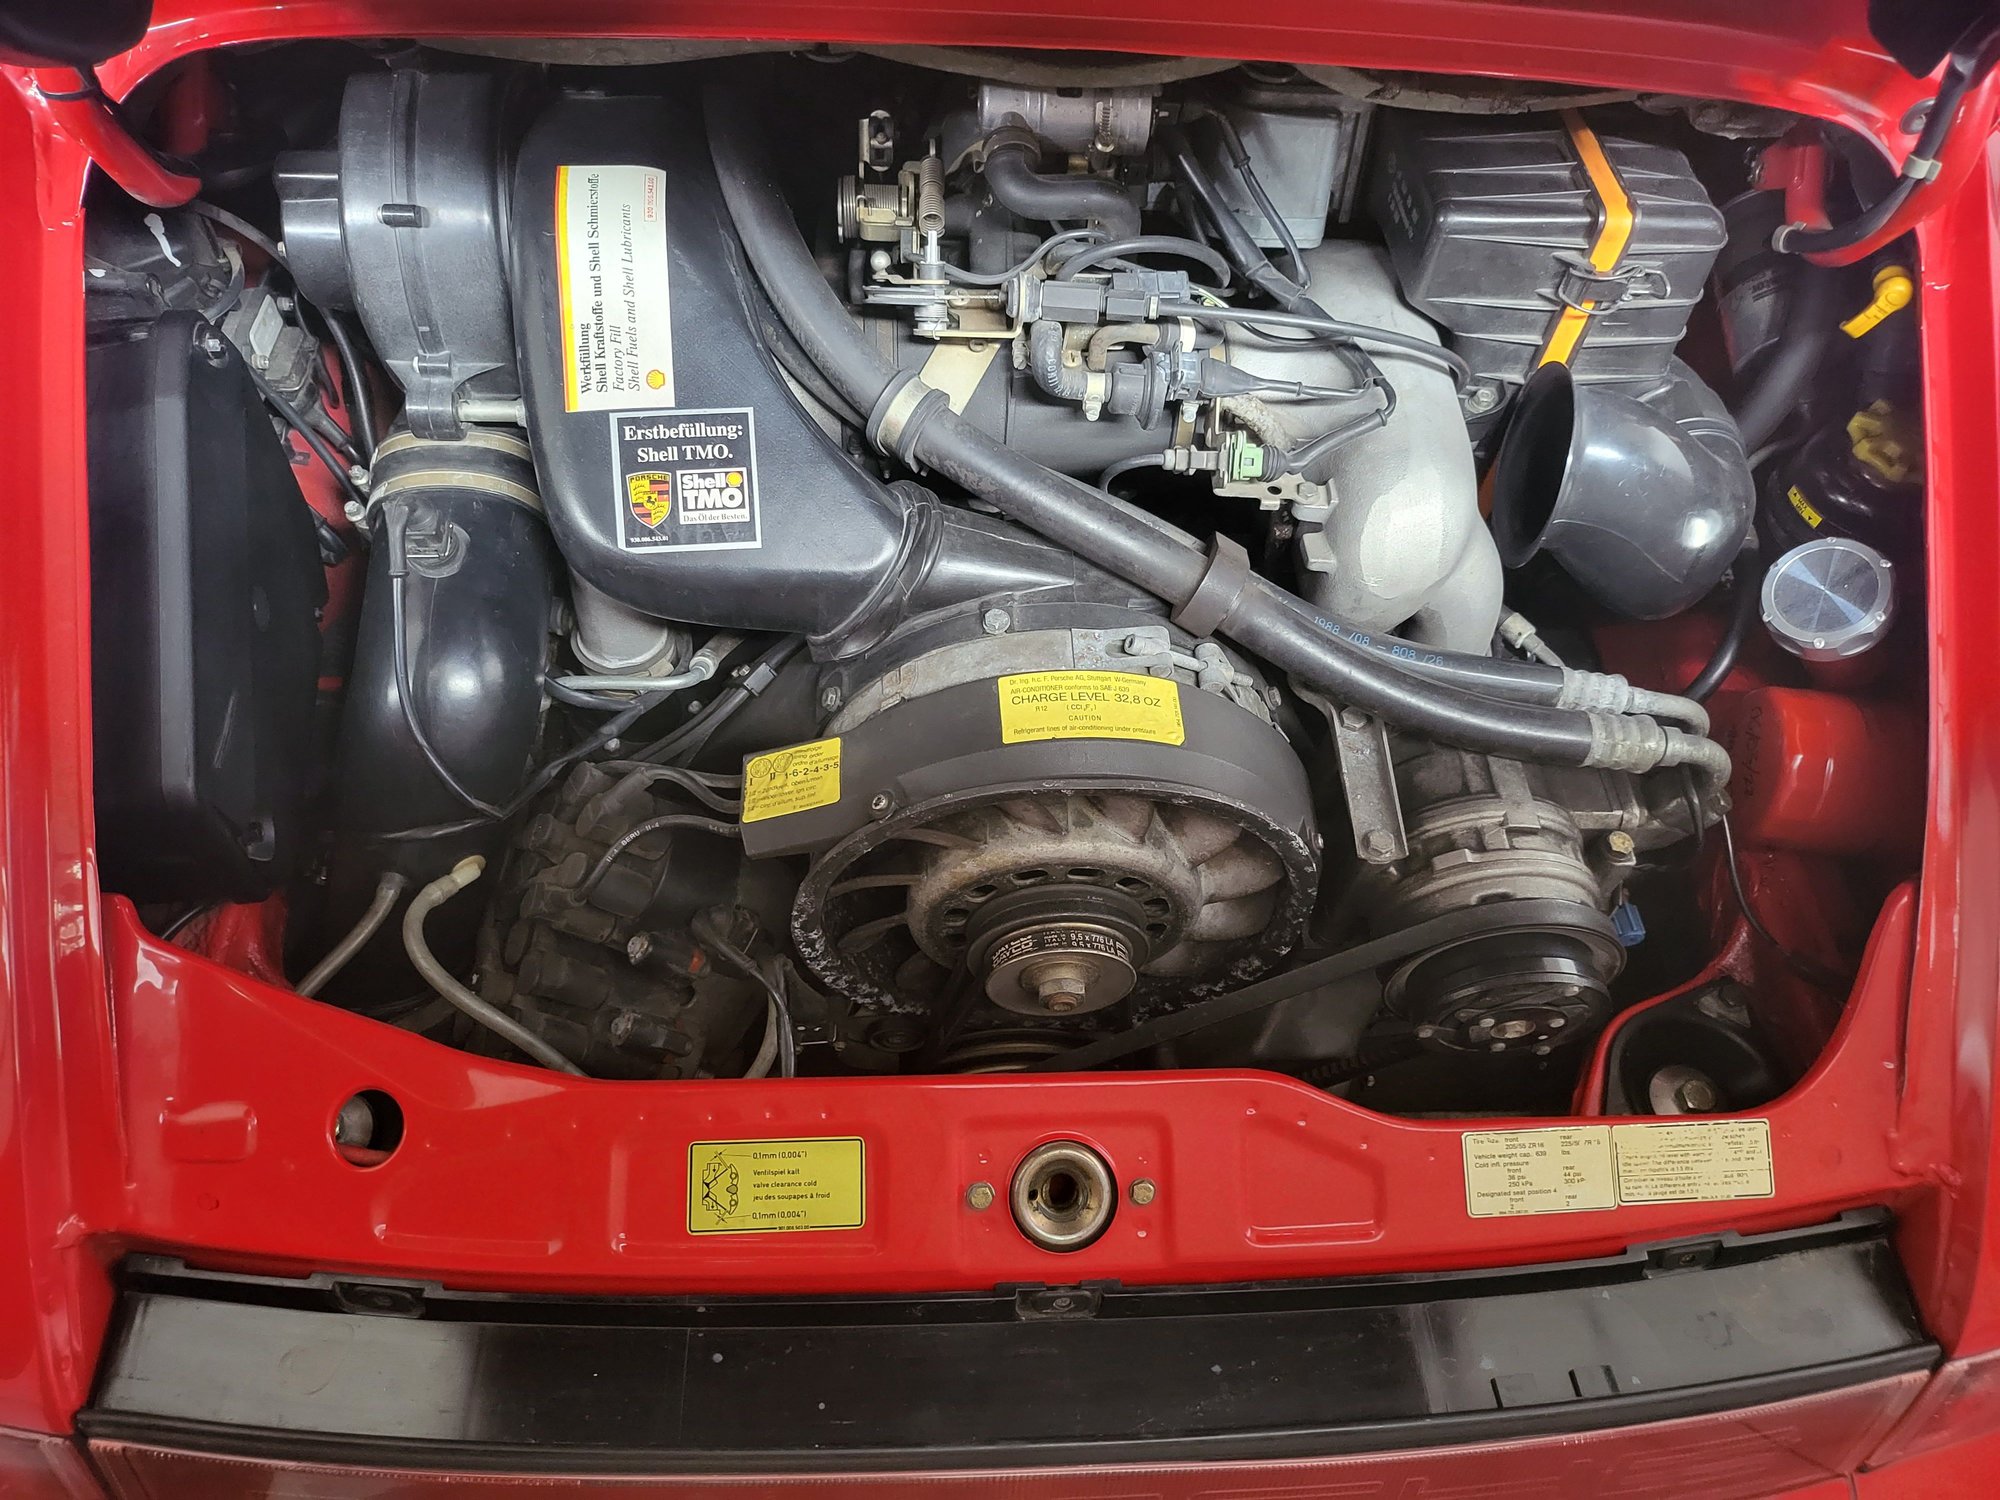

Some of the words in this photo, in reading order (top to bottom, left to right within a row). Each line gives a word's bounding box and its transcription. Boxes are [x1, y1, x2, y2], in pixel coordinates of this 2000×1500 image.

[620, 204, 633, 263] Lubricants
[589, 242, 601, 272] Shell
[590, 276, 602, 297] und
[623, 267, 635, 297] Shell
[624, 300, 636, 323] and
[592, 300, 606, 359] Kraftstoffe
[609, 325, 622, 345] Fill
[625, 326, 638, 357] Fuels
[579, 323, 592, 394] Werkfüllung
[595, 363, 608, 392] Shell
[613, 348, 625, 391] Factory
[627, 361, 640, 391] Shell
[623, 422, 743, 440] Erstbefüllung:
[637, 446, 678, 463] Shell
[682, 444, 733, 460] TMO.
[630, 474, 669, 482] PORSCHE
[682, 473, 727, 489] Shell
[683, 488, 743, 510] TMO
[698, 513, 707, 522] Öl
[1314, 616, 1340, 636] 1988
[1348, 632, 1370, 647] /08
[1391, 645, 1416, 660] 808
[1423, 654, 1444, 667] /26
[1010, 685, 1063, 694] AIR-CONDITIONER
[1012, 692, 1068, 705] CHARGE
[1070, 692, 1110, 701] LEVEL
[1114, 693, 1140, 704] 32,8
[1144, 696, 1161, 708] OZ
[1014, 727, 1045, 735] Refrigerant
[785, 762, 839, 779] 1-6-2-4-3-5
[621, 830, 641, 846] BERU
[1070, 933, 1083, 941] 9,5
[1091, 934, 1104, 943] 776
[1106, 937, 1114, 946] LA
[753, 1169, 786, 1177] Ventilspiel
